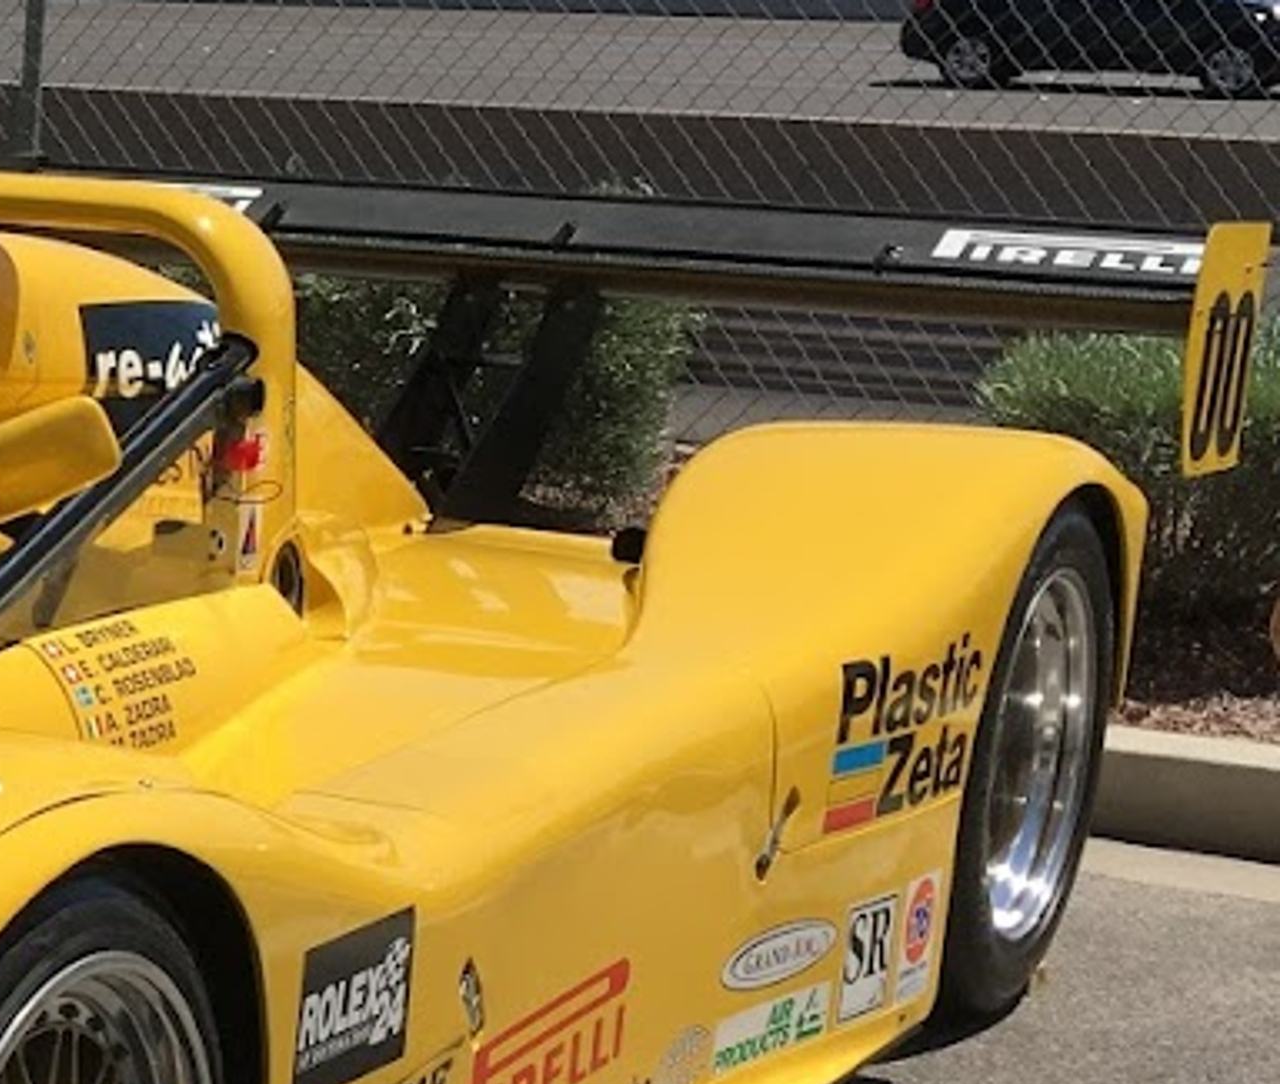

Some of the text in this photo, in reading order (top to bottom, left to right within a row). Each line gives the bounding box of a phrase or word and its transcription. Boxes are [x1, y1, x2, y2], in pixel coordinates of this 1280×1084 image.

[932, 229, 1205, 275] PIRELLI
[1190, 290, 1256, 461] 00
[837, 631, 982, 744] Plastic
[875, 724, 966, 817] Zeta
[843, 907, 891, 985] SR
[299, 963, 386, 1052] ROLEX
